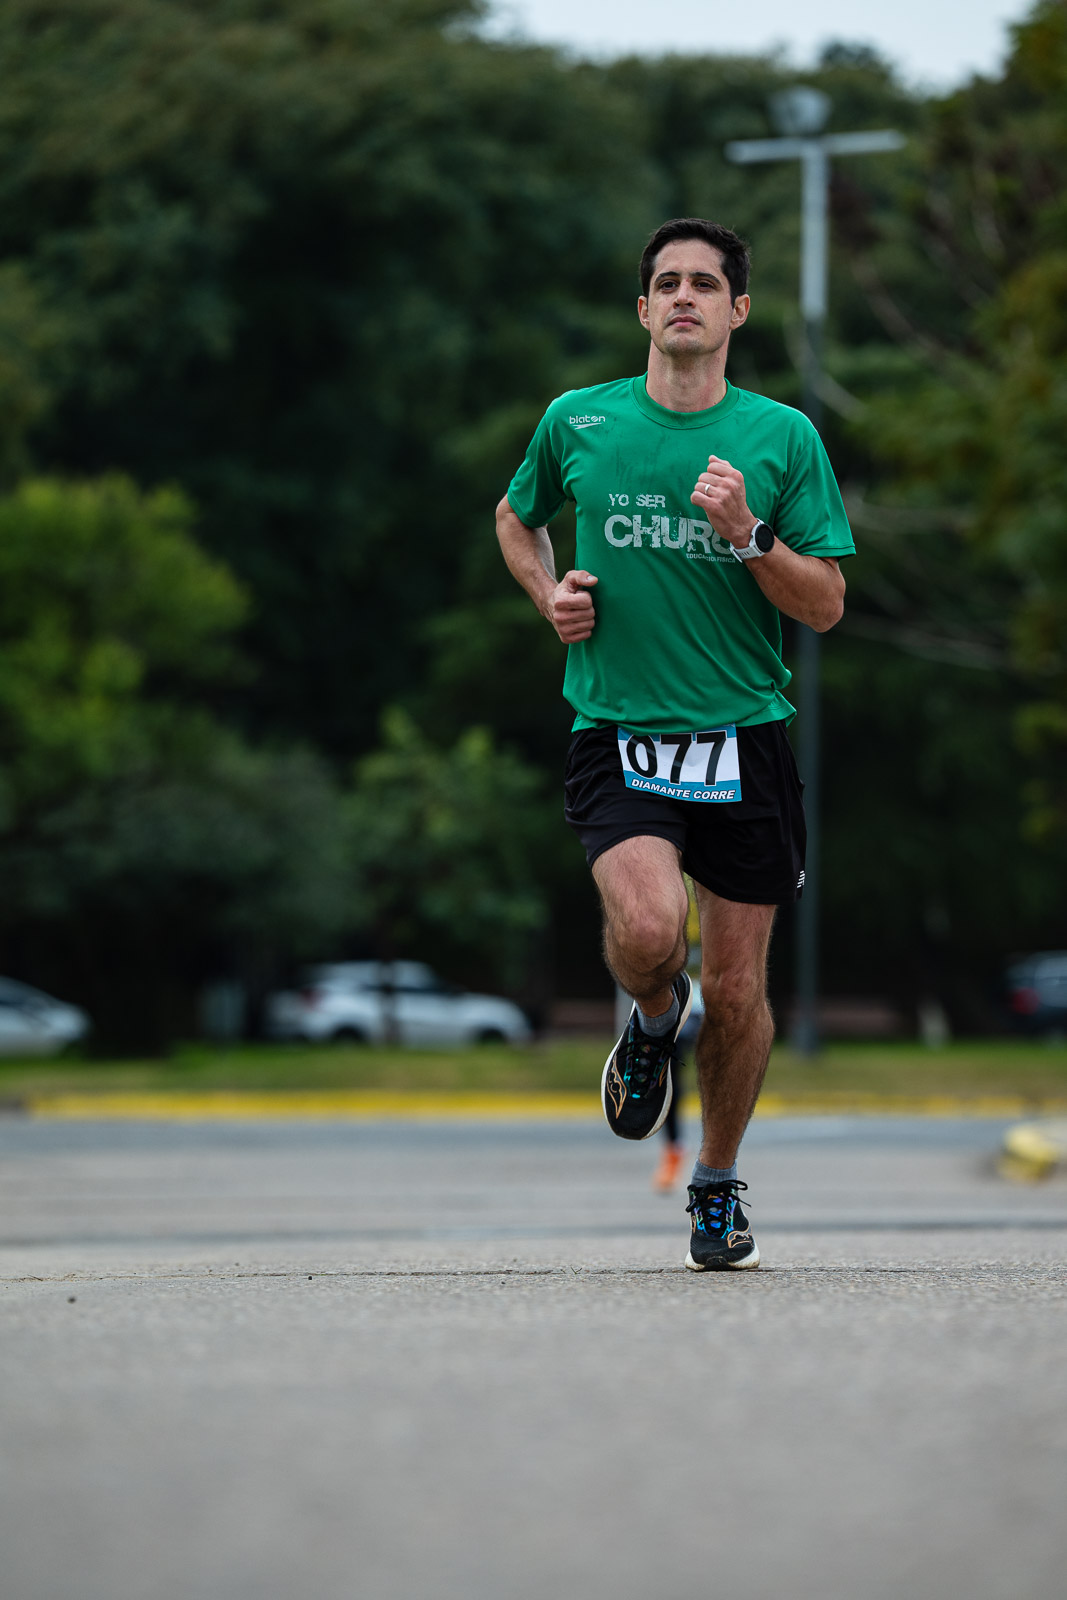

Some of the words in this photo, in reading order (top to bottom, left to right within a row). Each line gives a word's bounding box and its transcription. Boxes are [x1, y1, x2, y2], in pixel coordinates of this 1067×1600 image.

[608, 493, 629, 506] YO
[635, 494, 666, 508] SER
[626, 730, 727, 787] 077
[631, 779, 691, 798] DIAMANTE
[693, 789, 736, 800] CORRE
